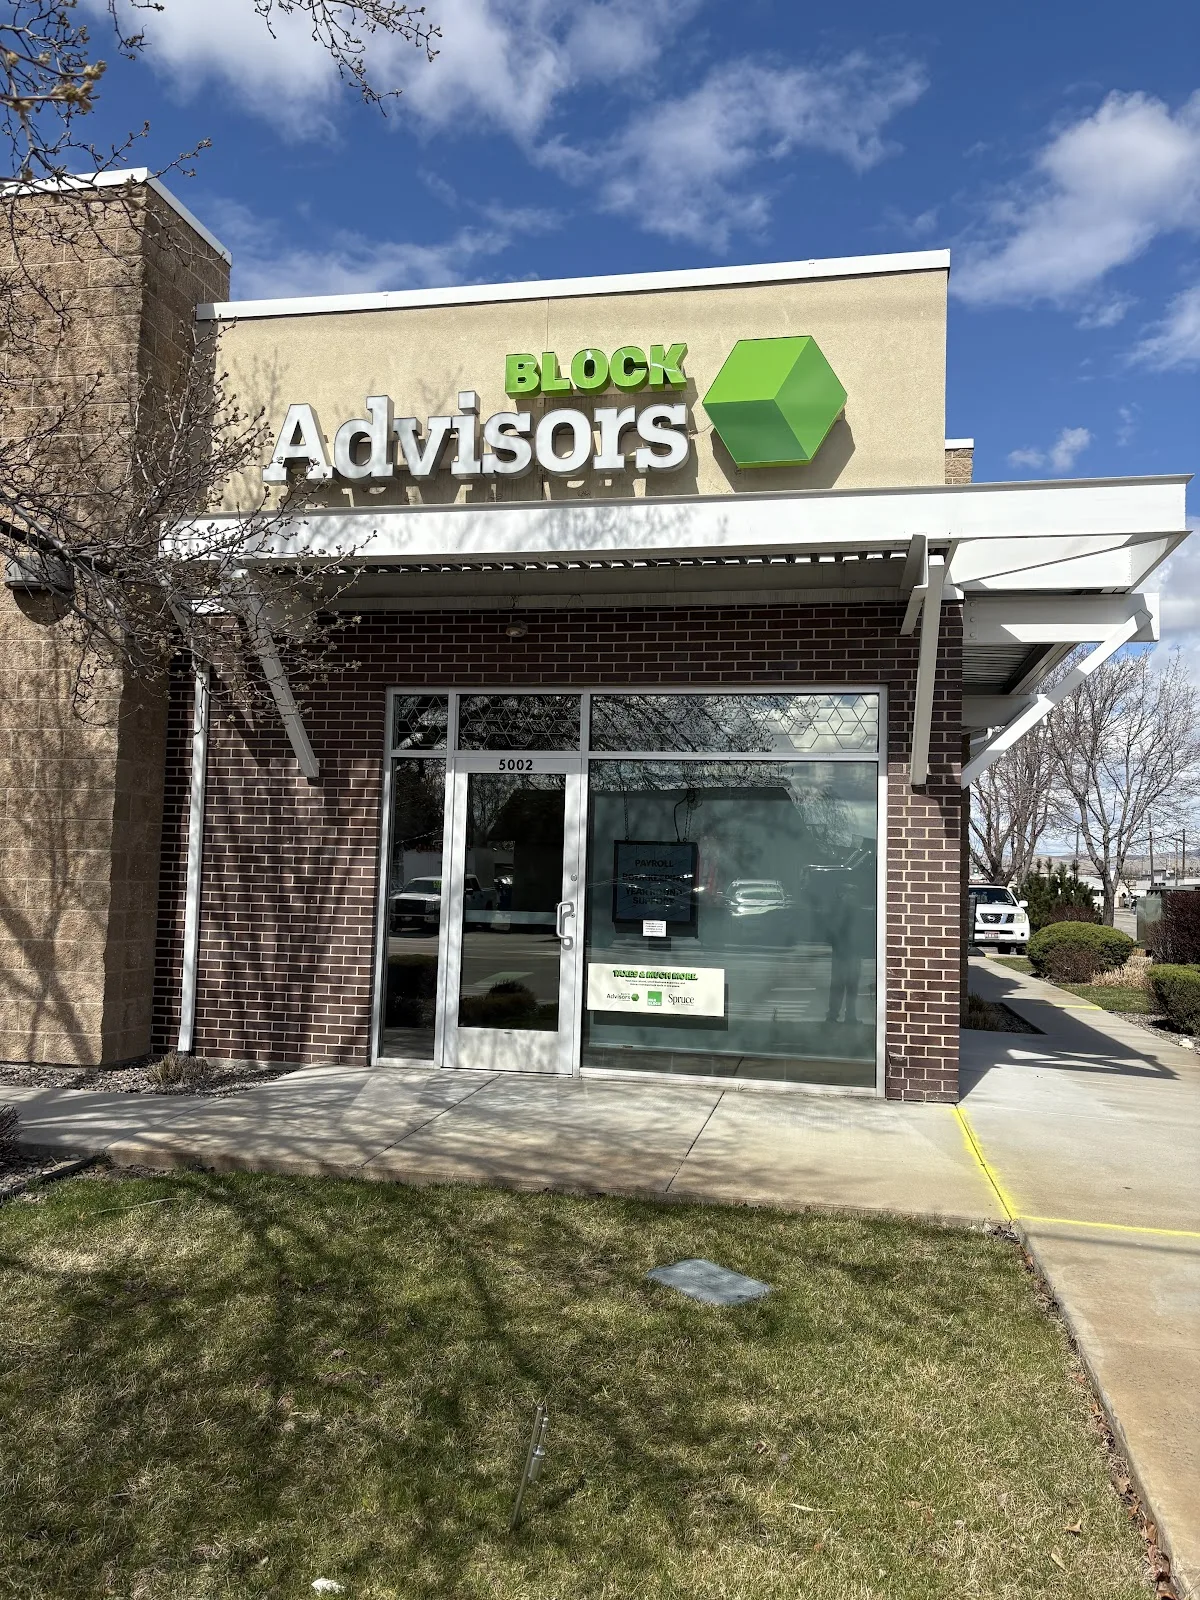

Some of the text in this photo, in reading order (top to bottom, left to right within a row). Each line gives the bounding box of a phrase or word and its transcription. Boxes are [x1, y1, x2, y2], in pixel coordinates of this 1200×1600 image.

[505, 343, 688, 399] BLOCK
[262, 391, 690, 483] Advisors
[499, 759, 533, 771] 5002
[635, 860, 674, 868] PAYROLL
[646, 971, 672, 980] MUCH
[667, 993, 695, 1006] Spruce
